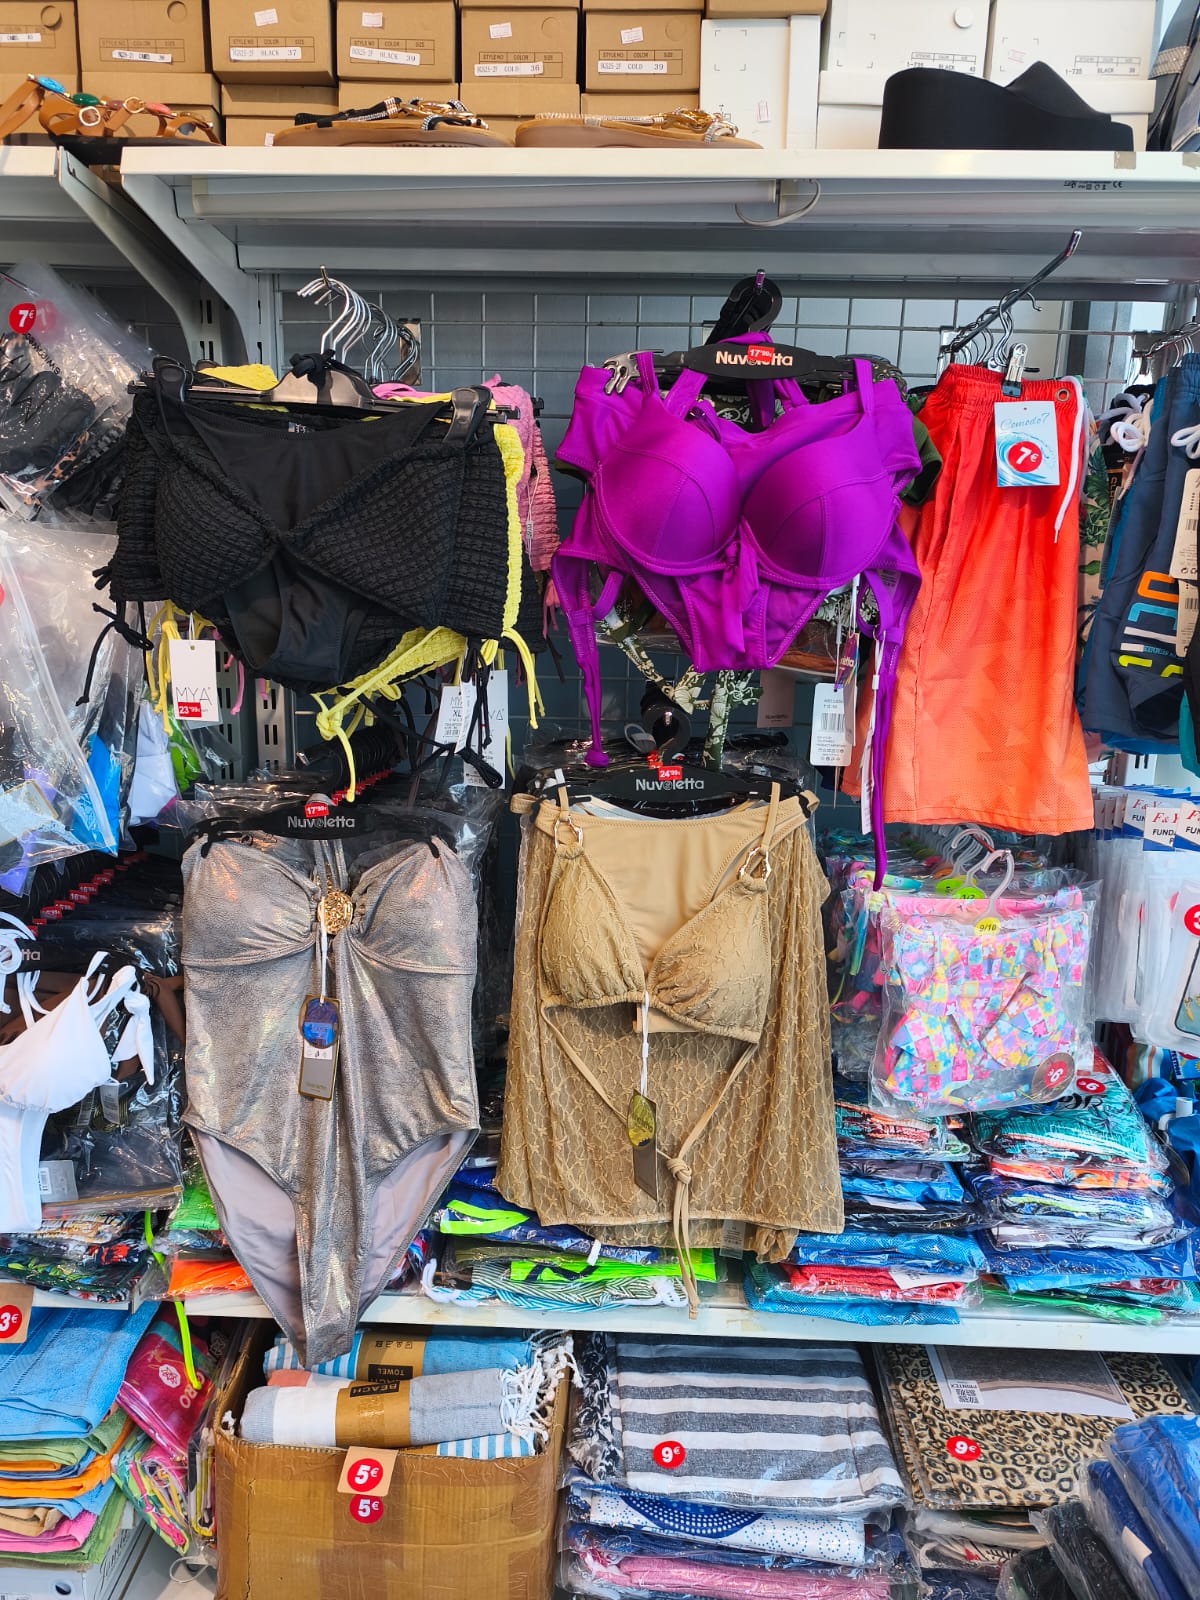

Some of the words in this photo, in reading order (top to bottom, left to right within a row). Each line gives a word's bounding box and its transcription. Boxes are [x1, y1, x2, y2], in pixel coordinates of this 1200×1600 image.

[287, 49, 297, 57] 37
[654, 63, 665, 71] 39
[18, 309, 35, 328] 7€
[1015, 446, 1039, 465] 7€
[635, 777, 705, 791] Nuvoletta
[287, 815, 355, 829] Nuvoletta
[0, 1311, 19, 1332] 3€
[379, 1367, 406, 1376] TOWEL
[351, 1382, 398, 1395] BEACH
[955, 1440, 978, 1454] 9€
[661, 1446, 681, 1463] 9€
[354, 1464, 380, 1485] 5€
[357, 1498, 380, 1518] 5€
